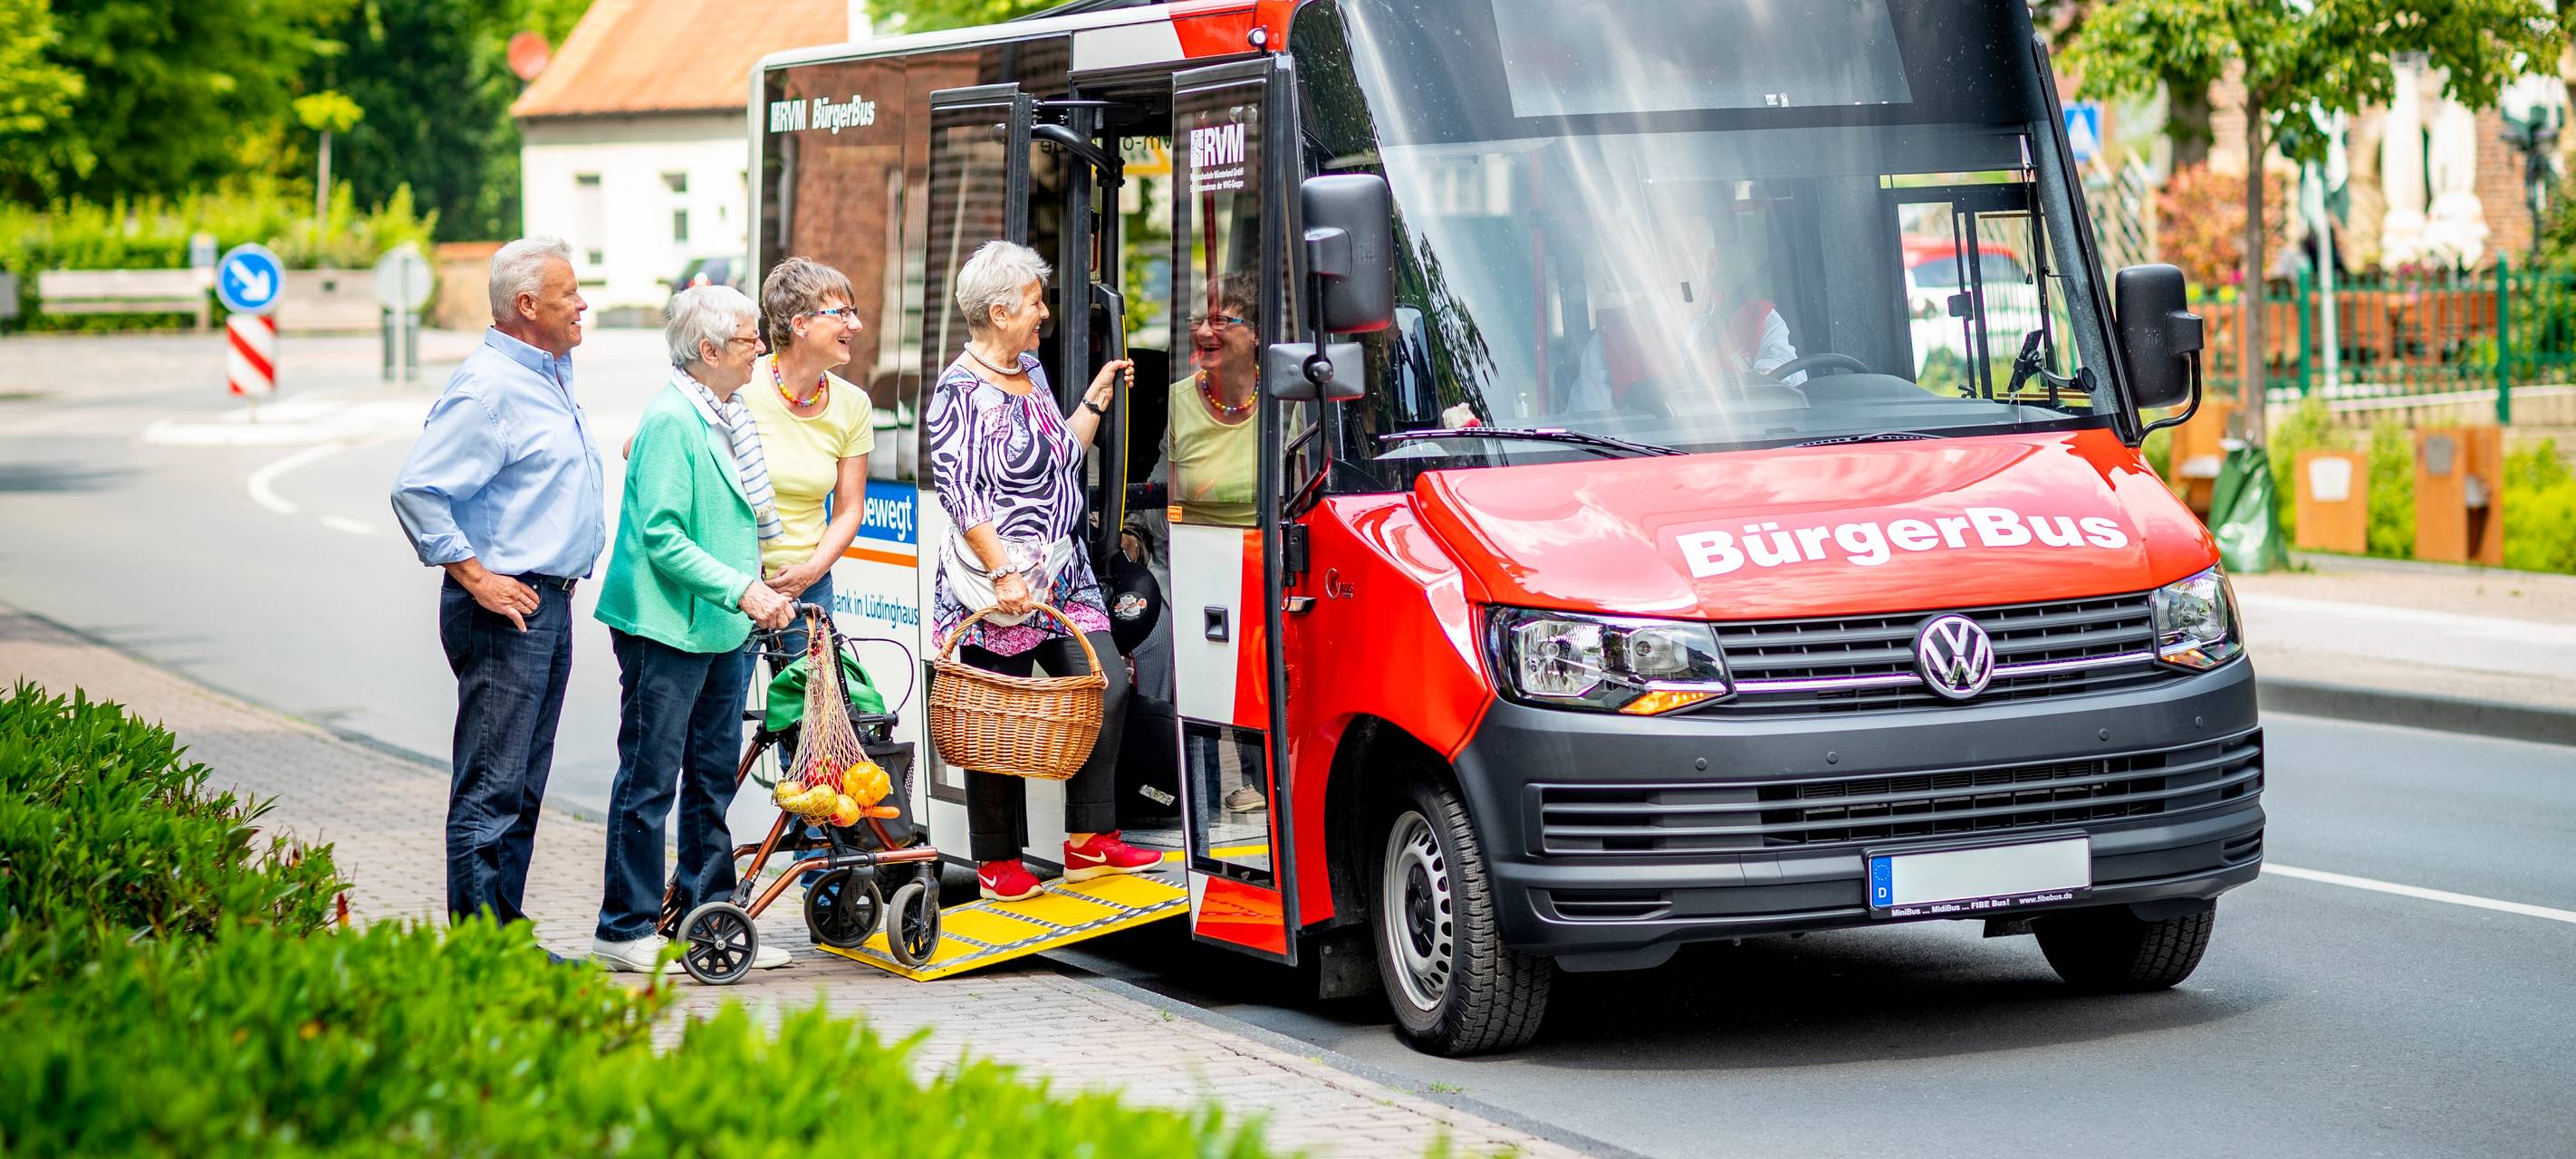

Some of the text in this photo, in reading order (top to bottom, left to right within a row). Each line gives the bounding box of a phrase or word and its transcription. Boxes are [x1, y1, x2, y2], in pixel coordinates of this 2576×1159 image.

[780, 95, 875, 134] RVM BürgerBus
[1204, 123, 1245, 167] RVM
[1676, 507, 2129, 579] BürgerBus
[854, 590, 863, 616] in
[1878, 887, 1887, 898] D
[1891, 908, 1921, 917] MiniBus
[1931, 905, 1960, 914] MidiBus
[1970, 901, 1990, 909] FIBE
[1992, 899, 2010, 908] Bus!
[2019, 893, 2073, 905] www.fibebus.de
